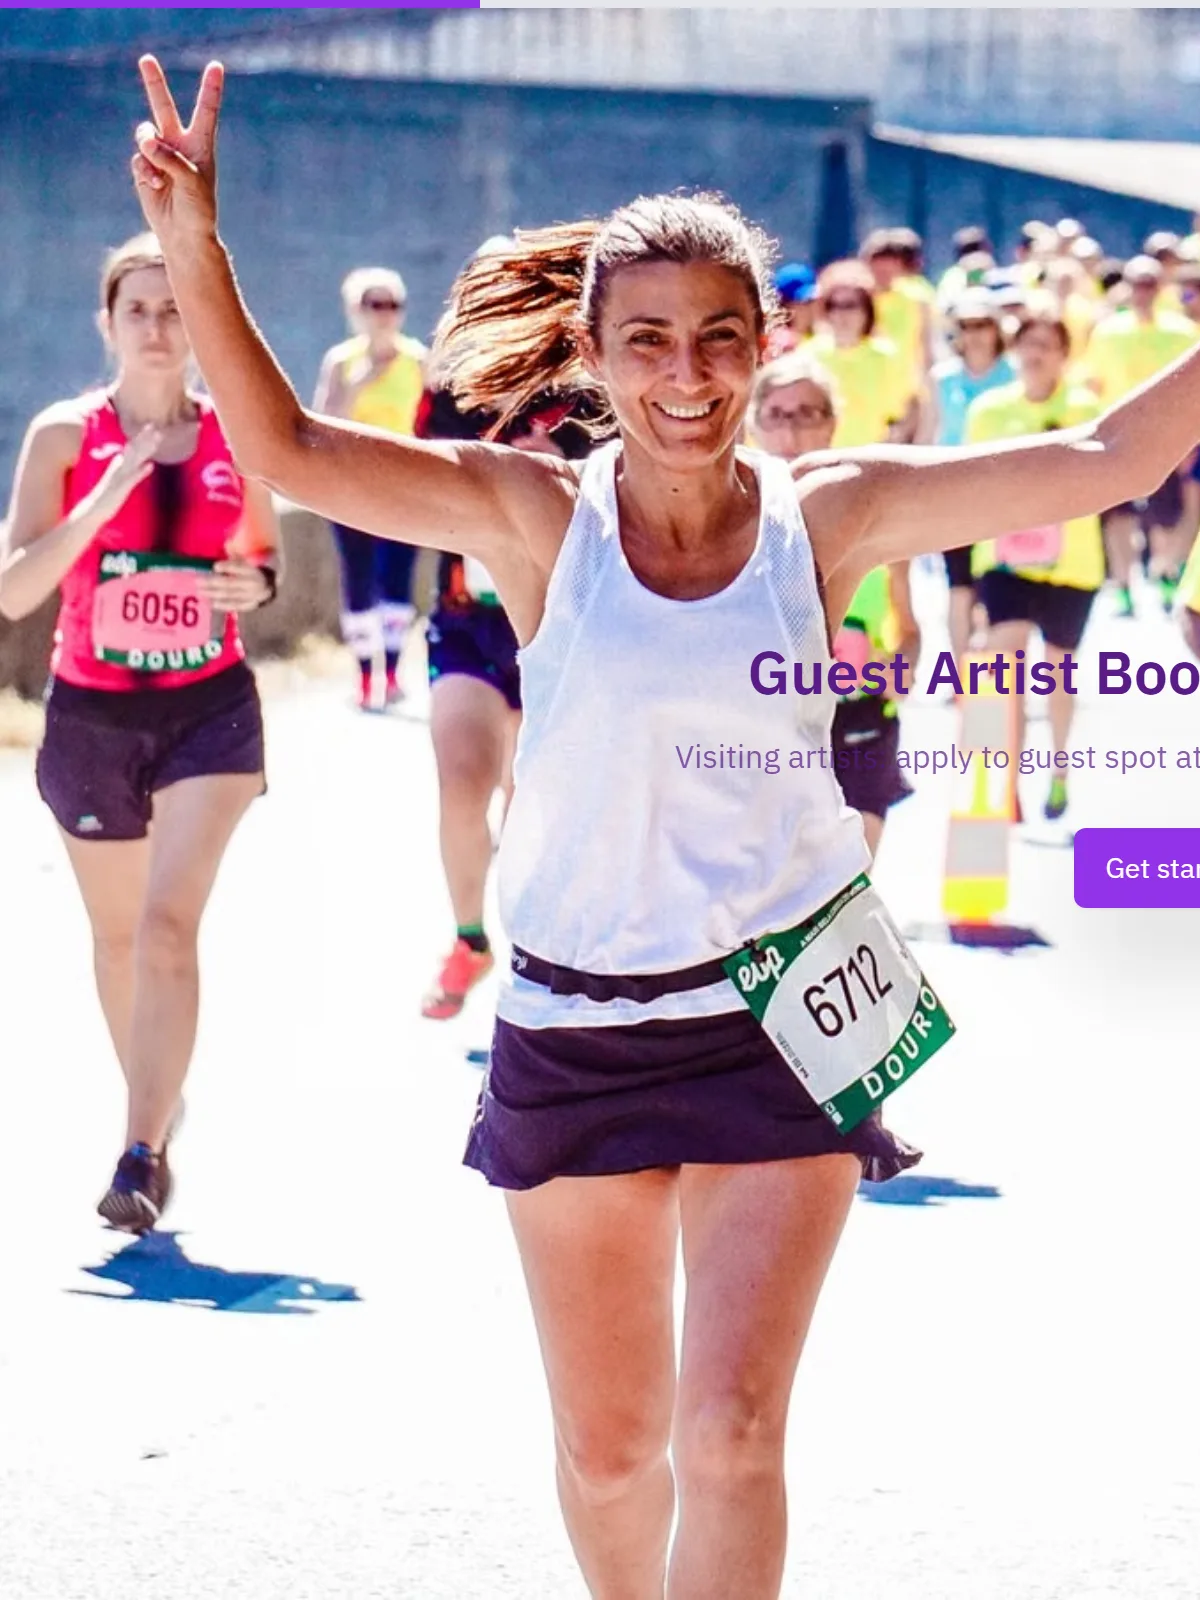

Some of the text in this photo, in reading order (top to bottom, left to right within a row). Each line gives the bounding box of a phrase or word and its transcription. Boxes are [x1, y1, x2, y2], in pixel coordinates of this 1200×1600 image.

[122, 590, 199, 628] 6056
[127, 638, 223, 670] DOURO
[803, 943, 893, 1038] 6712
[861, 985, 938, 1099] DOURO
